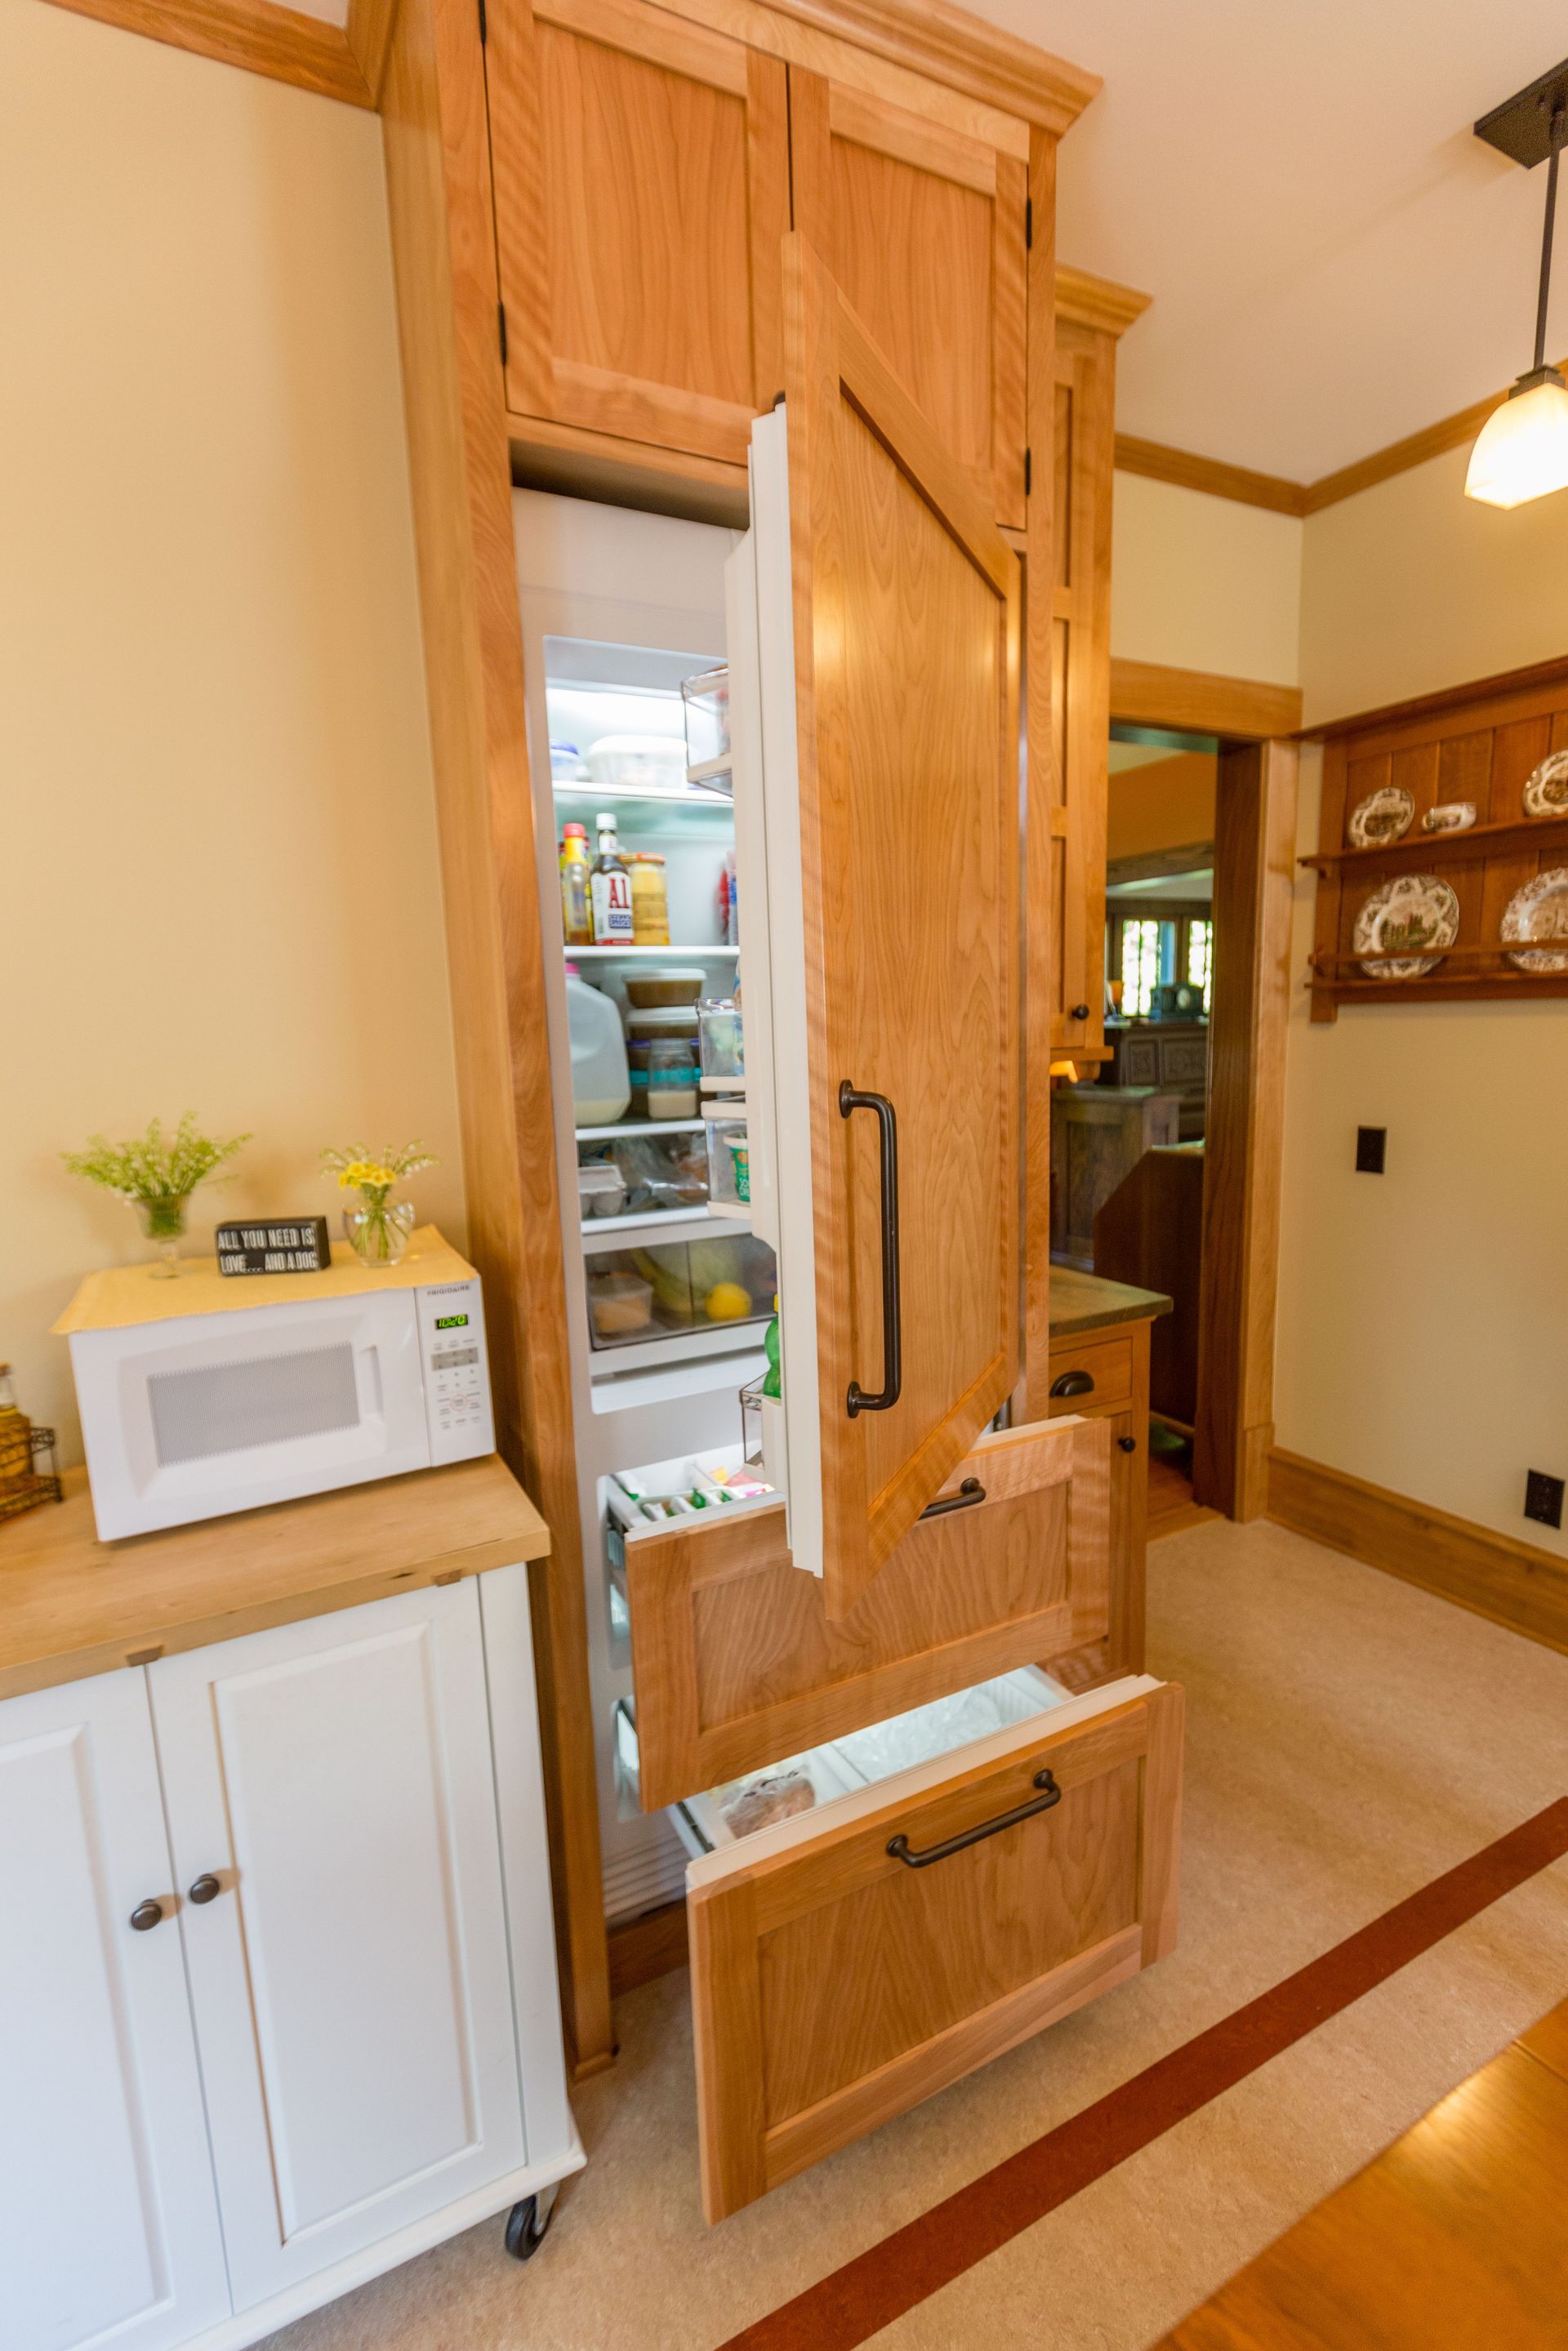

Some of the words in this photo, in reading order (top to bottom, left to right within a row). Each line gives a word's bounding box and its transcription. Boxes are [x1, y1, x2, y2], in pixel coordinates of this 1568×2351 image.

[739, 1178, 749, 1187] SO
[218, 1231, 240, 1249] ALL
[241, 1228, 268, 1249] YOU
[268, 1227, 300, 1248] NEED
[301, 1227, 316, 1246] IS
[265, 1253, 287, 1271] AND
[287, 1251, 296, 1270] A
[295, 1251, 317, 1270] DOG
[427, 1285, 470, 1295] FRIGIDAIRE
